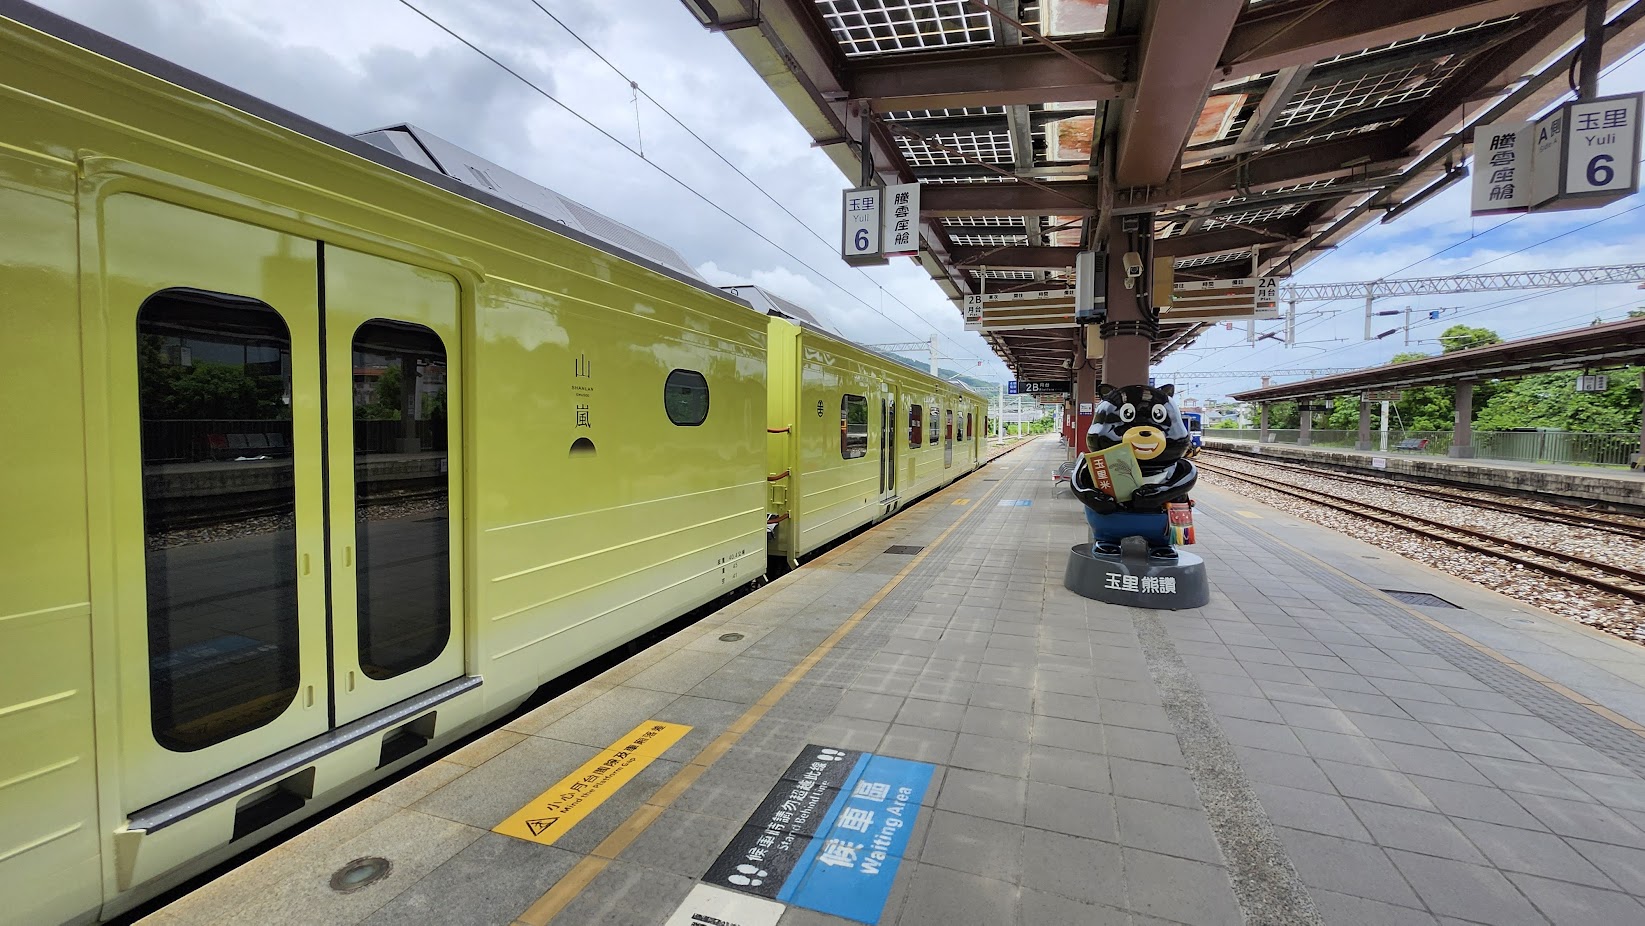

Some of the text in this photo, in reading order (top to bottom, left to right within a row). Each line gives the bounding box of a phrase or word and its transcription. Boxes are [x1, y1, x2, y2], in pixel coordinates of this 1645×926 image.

[1576, 108, 1628, 131] 玉里
[1585, 133, 1616, 146] Yuli
[1489, 132, 1516, 201] 騰雲座艙
[1586, 154, 1614, 186] 6
[848, 197, 875, 212] 玉里
[853, 214, 869, 222] Yuli
[894, 192, 910, 245] 騰雲座艙
[854, 228, 869, 251] 6
[1258, 278, 1276, 288] 2A
[1258, 288, 1275, 297] 月台
[968, 295, 982, 304] 2B
[575, 353, 591, 378] 山
[1025, 383, 1039, 392] 2B
[575, 403, 591, 428] 嵐
[1093, 458, 1110, 489] 玉里米
[1104, 572, 1177, 594] 玉里熊讚
[560, 757, 636, 814] Mind the Platform Gap
[746, 762, 827, 862] 候車時請勿超越此線
[777, 780, 829, 851] Stand Behind Line
[820, 779, 891, 868] 候車區
[860, 787, 913, 875] Waiting Area
